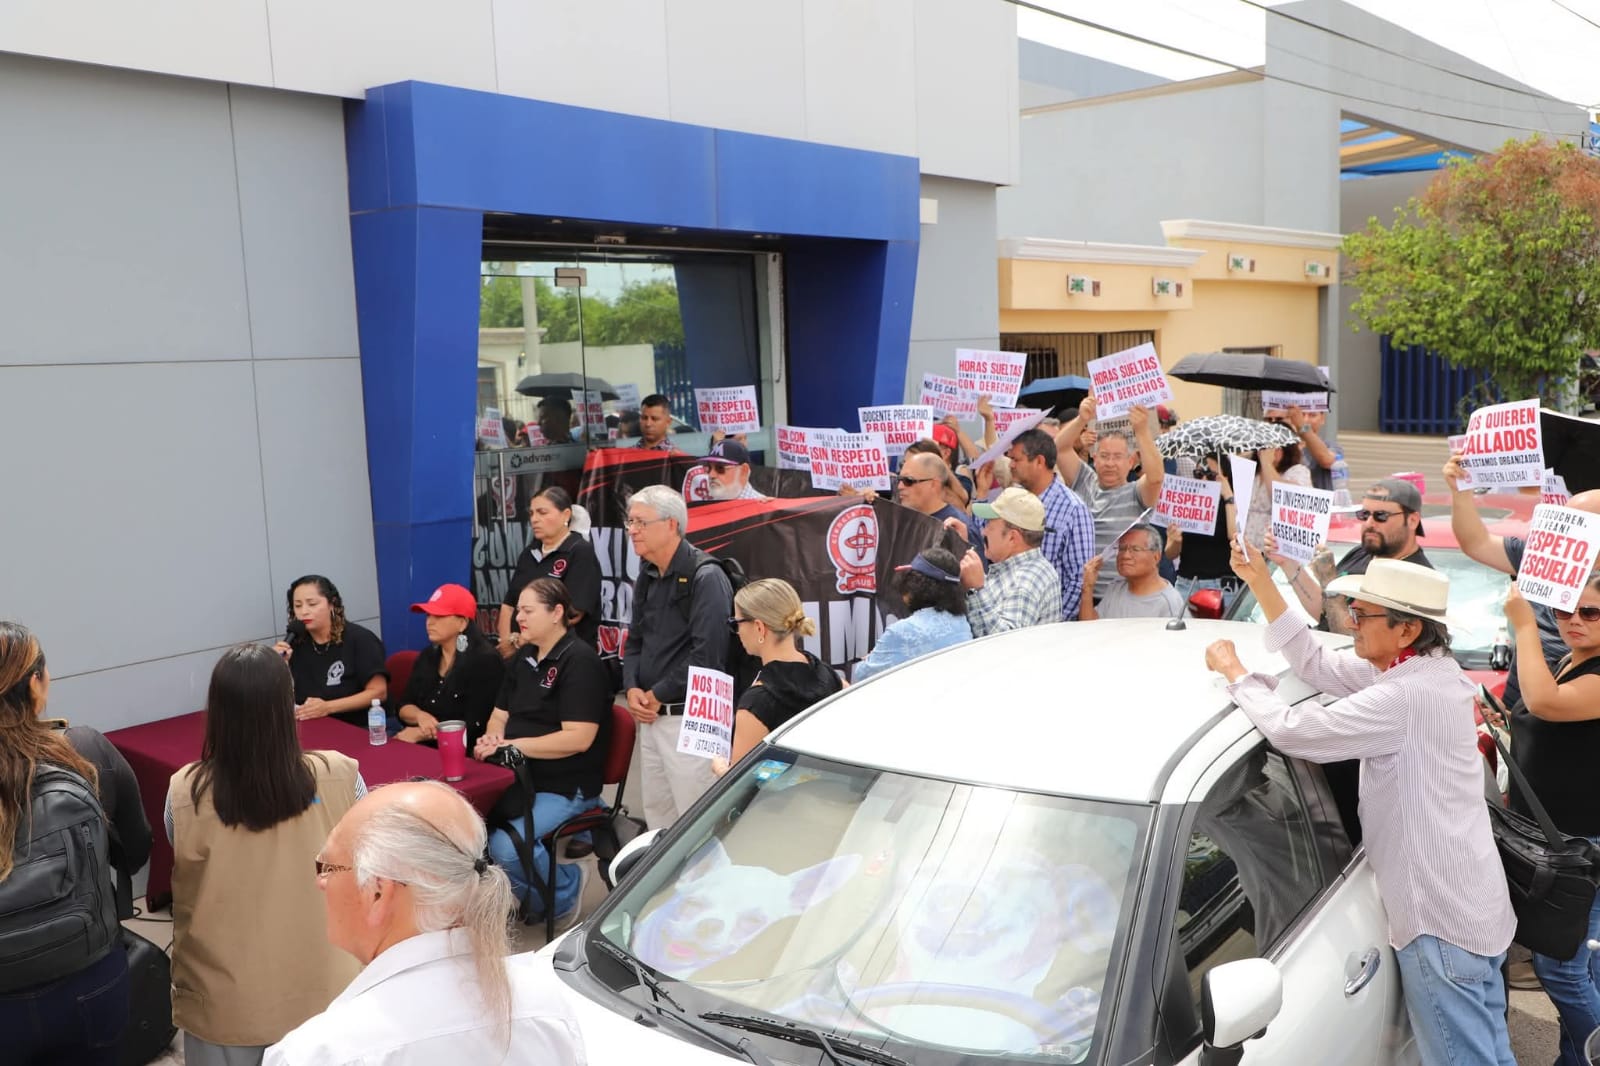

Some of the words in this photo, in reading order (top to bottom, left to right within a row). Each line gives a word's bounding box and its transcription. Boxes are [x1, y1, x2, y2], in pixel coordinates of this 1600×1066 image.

[959, 360, 987, 374] HORAS
[990, 362, 1023, 377] SUELTAS
[1093, 368, 1119, 386] HORAS
[1119, 356, 1158, 379] SUELTAS
[924, 380, 933, 390] NO
[934, 383, 942, 392] ES
[958, 379, 975, 390] CON
[979, 380, 1018, 395] DERECHOS
[1097, 391, 1115, 406] CON
[1117, 377, 1165, 401] DERECHOS
[712, 400, 755, 412] RESPETO,
[893, 408, 930, 421] PRECARIO,
[720, 410, 756, 424] ESCUELA!
[1486, 407, 1536, 429] QUIEREN
[866, 421, 925, 433] PROBLEMA
[810, 446, 829, 460] ¡SIN
[831, 448, 886, 463] RESPETO,
[1472, 456, 1498, 467] ESTAMOS
[1499, 453, 1541, 466] ORGANIZADOS
[811, 461, 823, 475] NO
[825, 463, 838, 477] HAY
[841, 462, 887, 479] ESCUELA!
[1496, 472, 1505, 482] EN
[1506, 470, 1529, 482] LUCHA!
[1166, 489, 1215, 509] RESPETO,
[1283, 490, 1330, 514] UNIVERSITARIOS
[1172, 505, 1214, 522] ESCUELA!
[1287, 510, 1298, 526] NOS
[1299, 513, 1316, 530] HACE
[1273, 522, 1320, 548] DESECHABLES
[1544, 519, 1570, 535] VEAN!
[1521, 553, 1586, 590] ESCUELA!
[1521, 580, 1554, 600] LUCHA!
[691, 674, 712, 694] NOS
[684, 720, 698, 731] PERO
